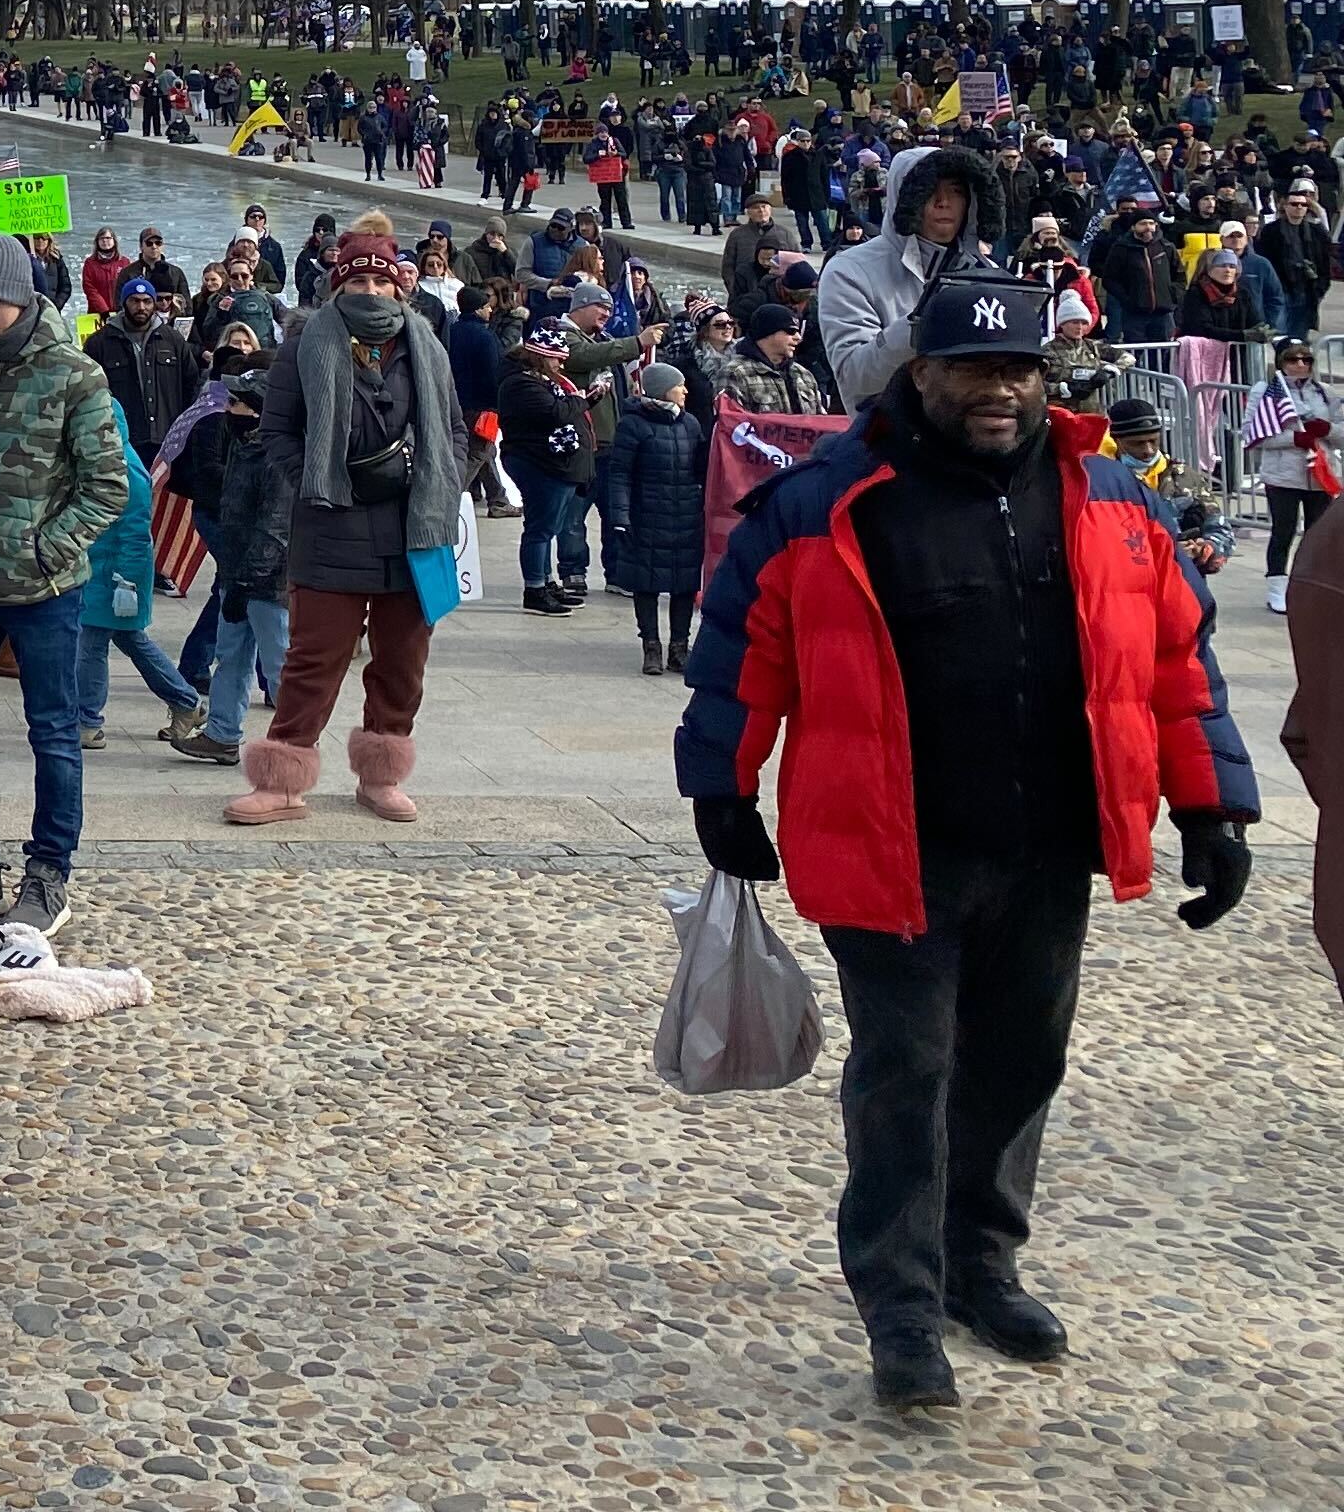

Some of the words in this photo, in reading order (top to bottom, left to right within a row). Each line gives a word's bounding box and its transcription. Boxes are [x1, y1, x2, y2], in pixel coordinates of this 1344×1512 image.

[4, 180, 44, 195] STOP
[6, 193, 53, 207] TYRANNY
[9, 204, 63, 219] ABSURDITY
[10, 215, 65, 232] MANDATES
[338, 253, 399, 277] bebe
[972, 296, 1008, 330] NY
